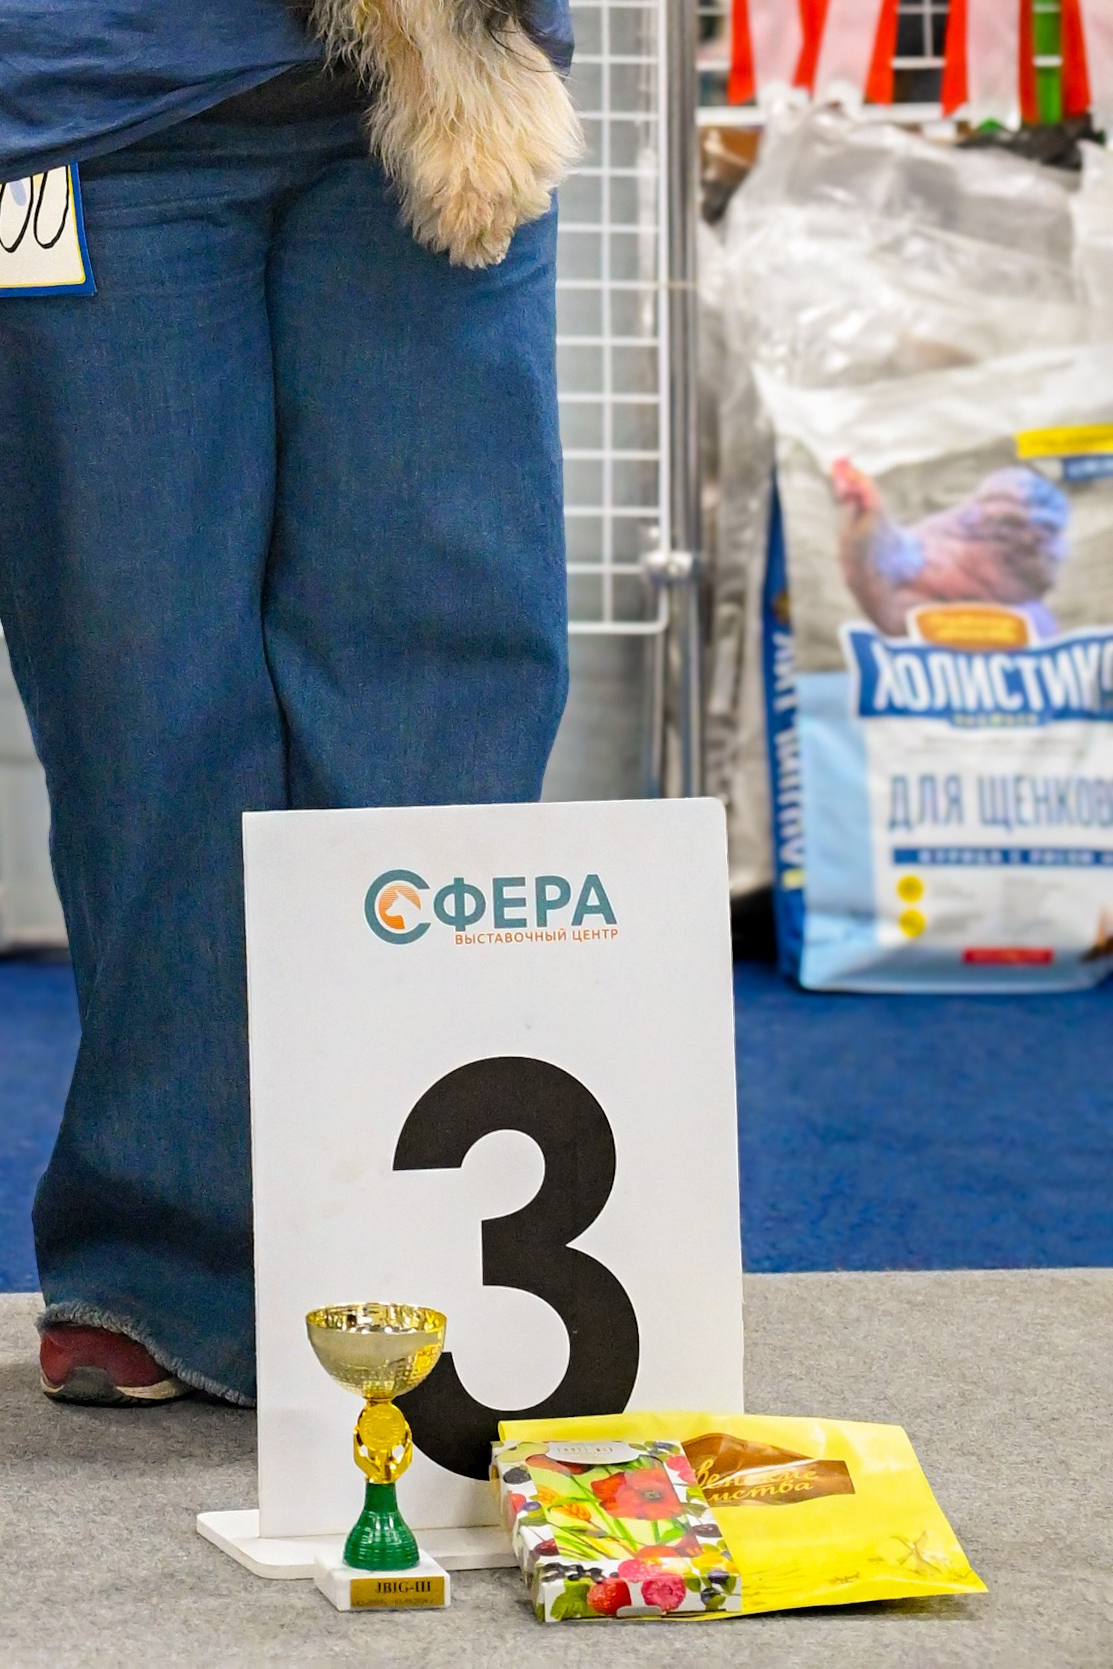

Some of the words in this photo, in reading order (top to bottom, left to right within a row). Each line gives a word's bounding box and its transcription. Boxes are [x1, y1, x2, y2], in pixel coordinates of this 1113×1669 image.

[889, 775, 964, 832] ДЛЯ
[364, 869, 618, 945] СФЕРА
[454, 929, 568, 945] ВЫСТАВОЧНЫЙ
[572, 928, 620, 943] ЦЕНТР
[392, 1056, 640, 1481] 3
